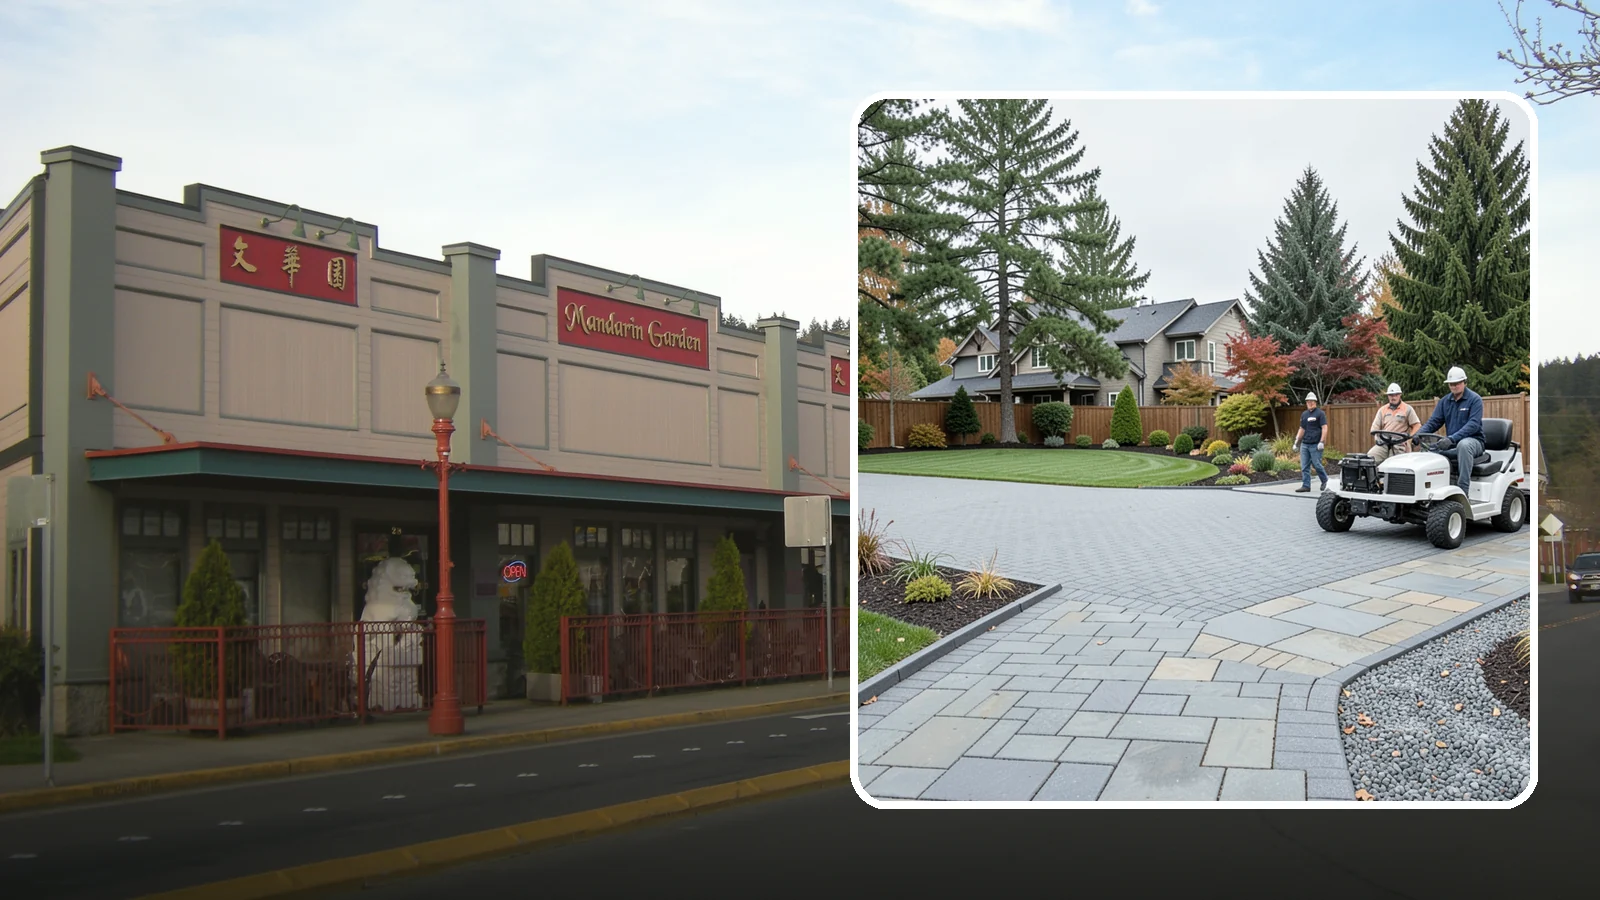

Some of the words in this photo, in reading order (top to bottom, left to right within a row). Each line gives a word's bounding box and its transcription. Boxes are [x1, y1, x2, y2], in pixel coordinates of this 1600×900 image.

[231, 236, 346, 290] 文華園
[565, 303, 643, 341] Mandarin
[648, 320, 701, 352] Garden
[503, 565, 527, 578] OPEN
